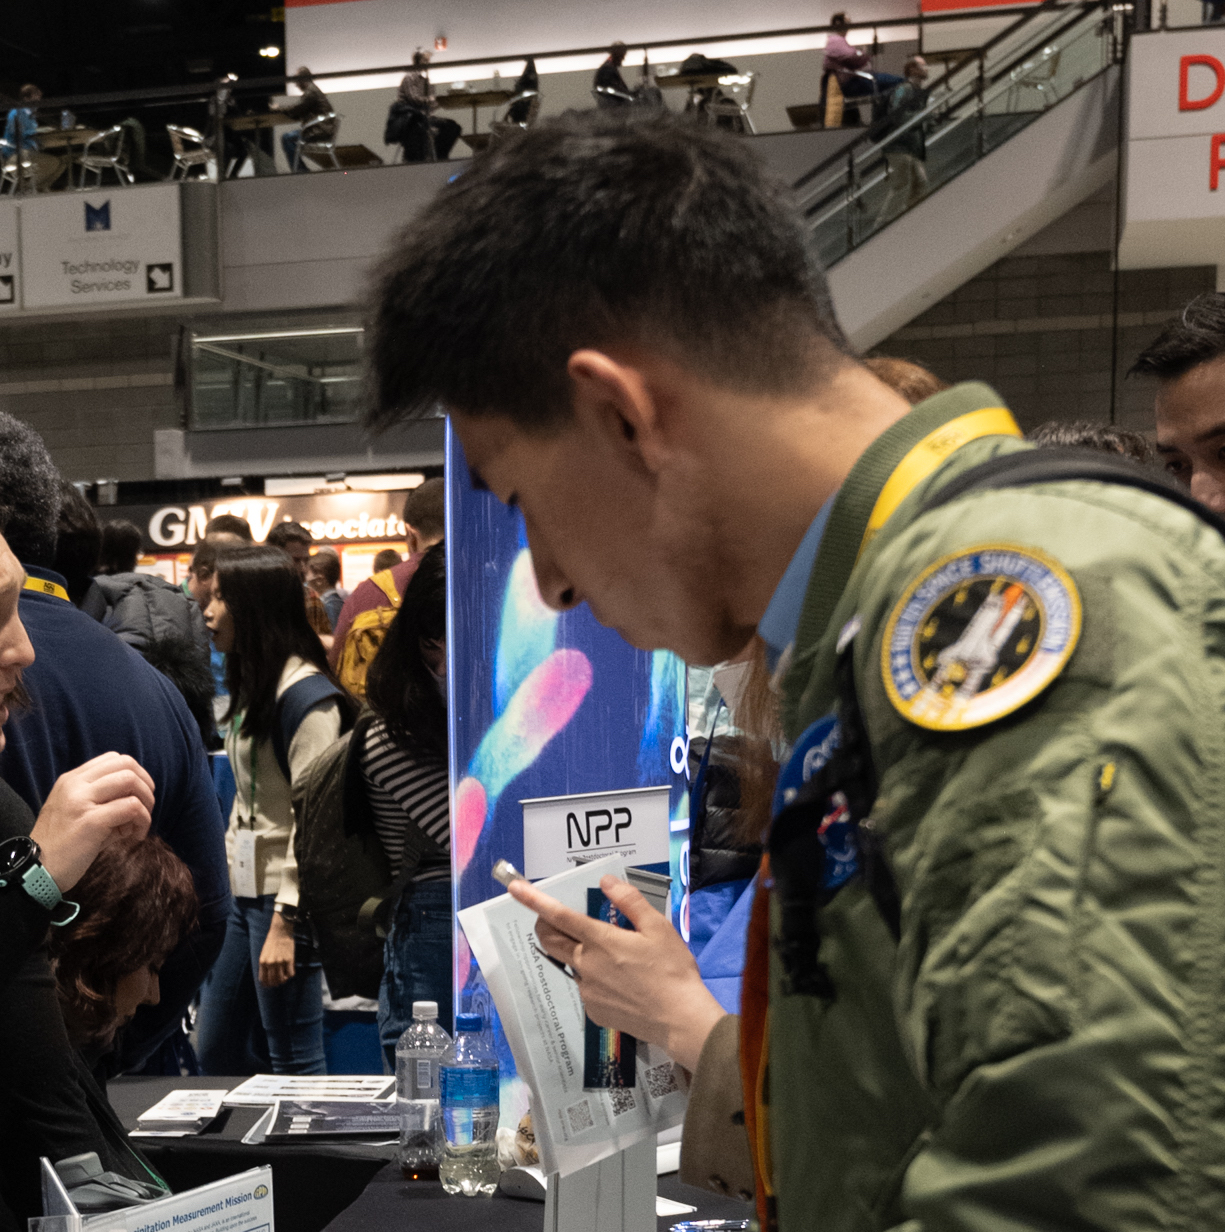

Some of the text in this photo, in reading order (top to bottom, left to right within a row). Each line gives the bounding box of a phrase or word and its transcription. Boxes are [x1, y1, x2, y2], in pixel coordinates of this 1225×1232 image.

[61, 258, 140, 278] Technology
[71, 277, 133, 295] Services
[566, 807, 632, 849] NPP
[524, 933, 540, 964] NASA
[534, 964, 562, 1032] Postdoctoral
[553, 1032, 577, 1078] Program
[172, 1201, 224, 1226] Measurement
[225, 1191, 253, 1210] Mission
